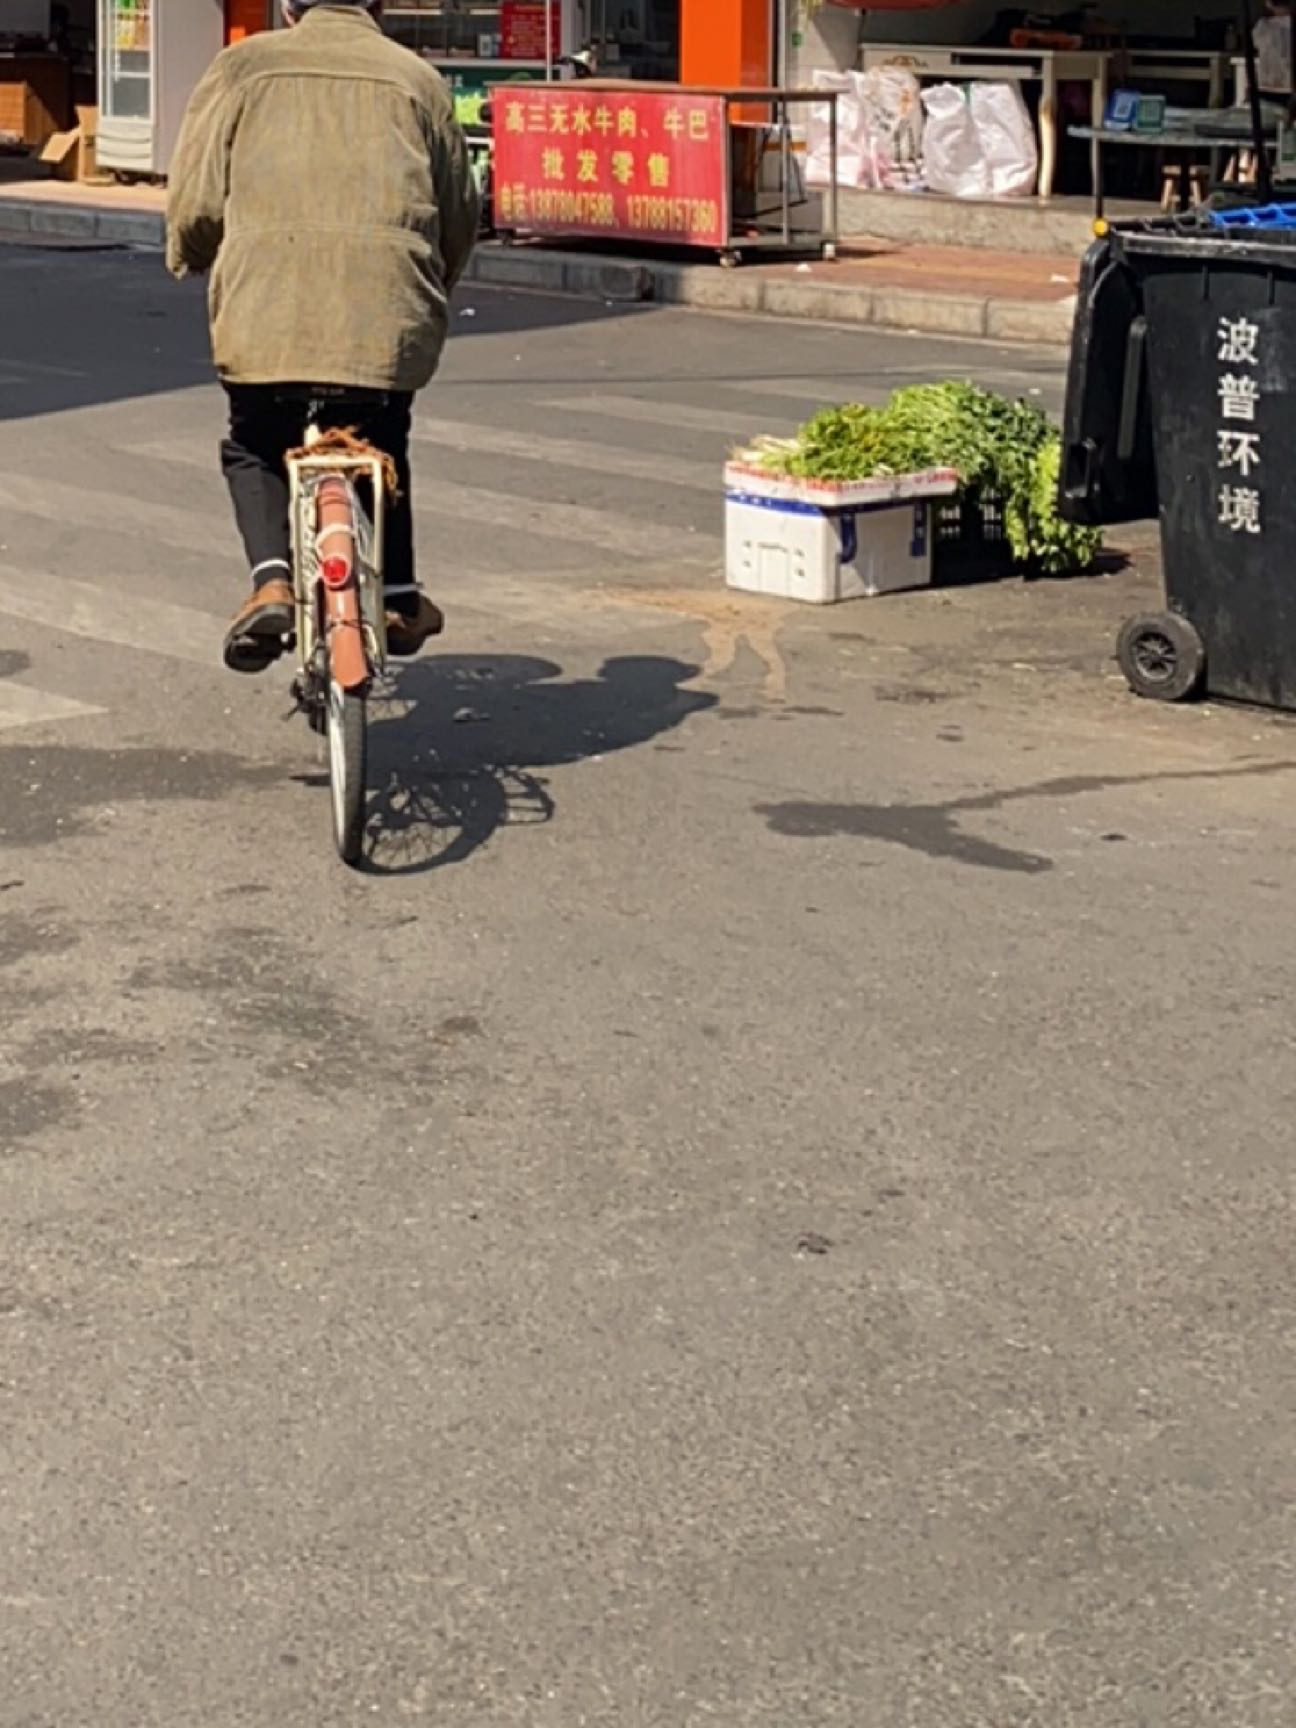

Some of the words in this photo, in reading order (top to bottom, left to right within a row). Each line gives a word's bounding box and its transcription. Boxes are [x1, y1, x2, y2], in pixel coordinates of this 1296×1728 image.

[542, 145, 669, 188] 批发零售
[1217, 317, 1260, 534] 波普环境
